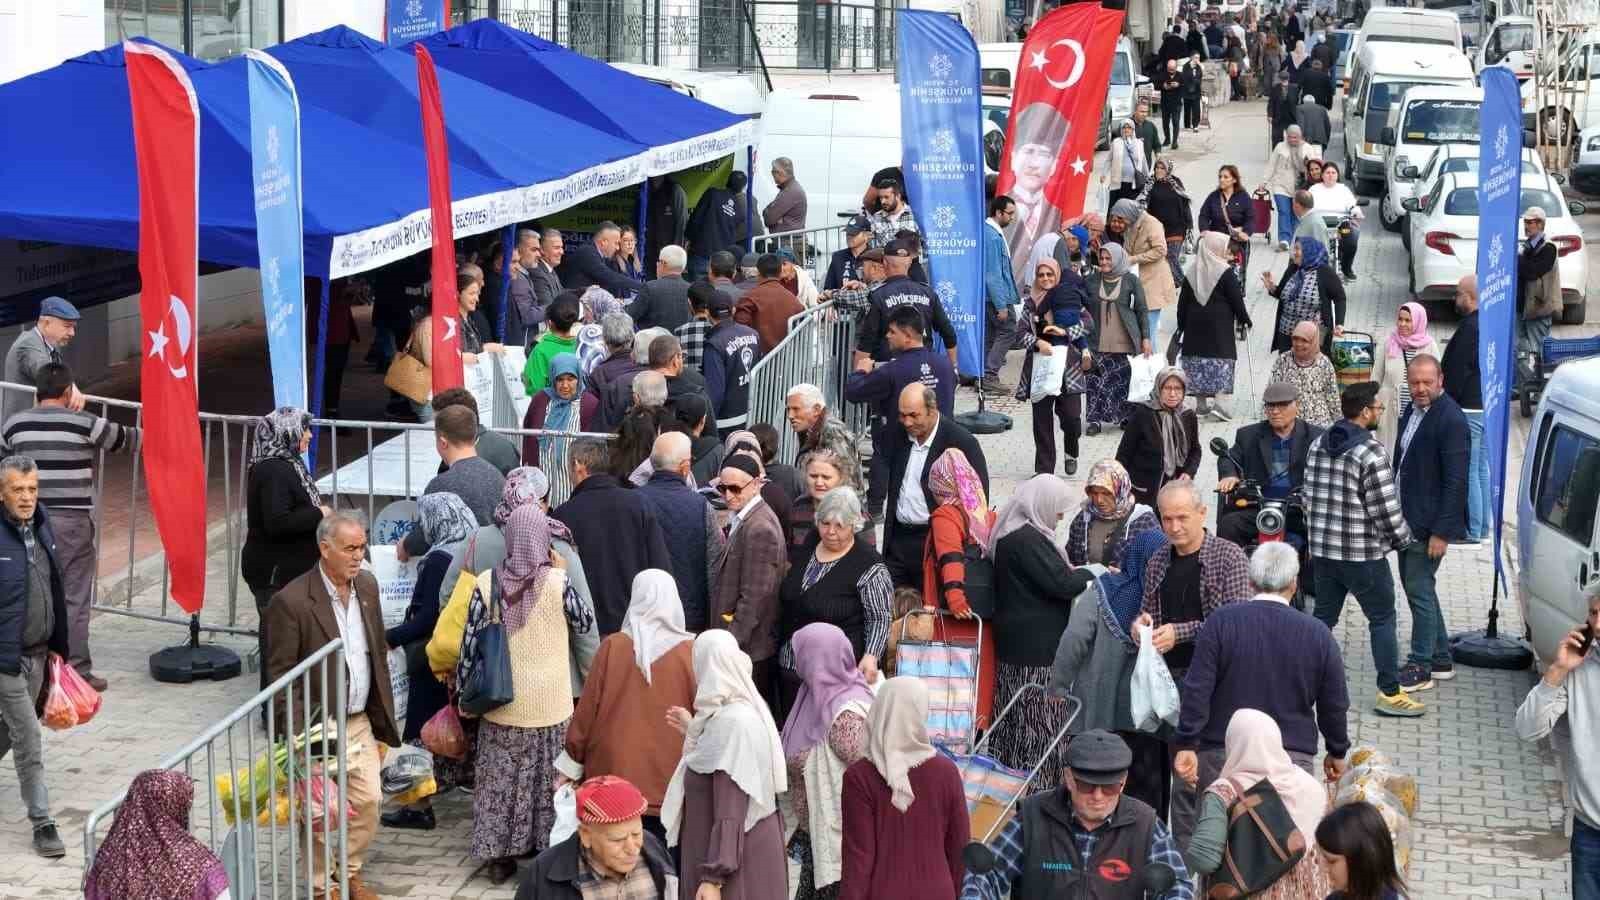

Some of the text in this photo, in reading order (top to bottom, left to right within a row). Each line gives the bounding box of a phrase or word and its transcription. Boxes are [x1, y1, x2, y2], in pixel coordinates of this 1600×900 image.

[885, 292, 930, 308] BÜYÜKŞEHİR
[726, 333, 759, 356] BÜYÜKŞEHİR
[1041, 862, 1073, 872] SIEMENS
